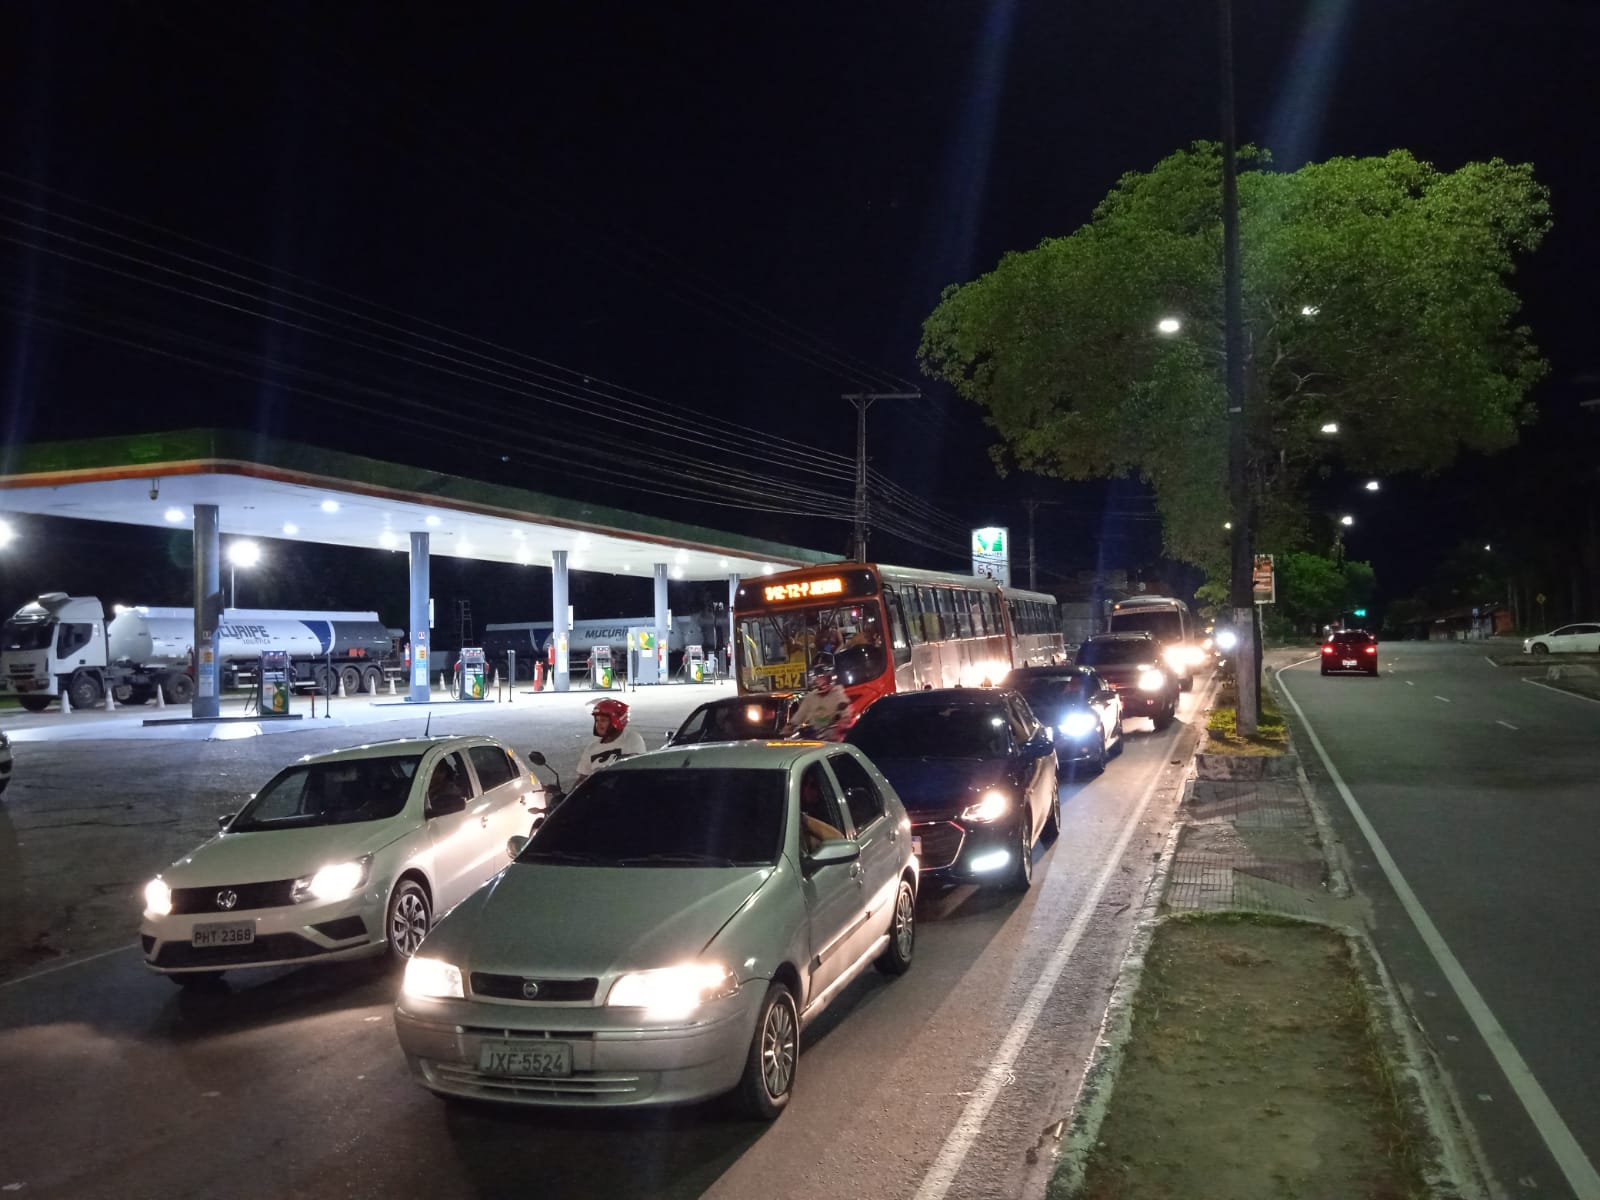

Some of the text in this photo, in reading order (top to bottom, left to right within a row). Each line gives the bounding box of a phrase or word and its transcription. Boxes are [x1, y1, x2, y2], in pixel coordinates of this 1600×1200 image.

[219, 625, 270, 638] CURIPE
[585, 627, 629, 639] MUCURI
[775, 672, 801, 689] 542
